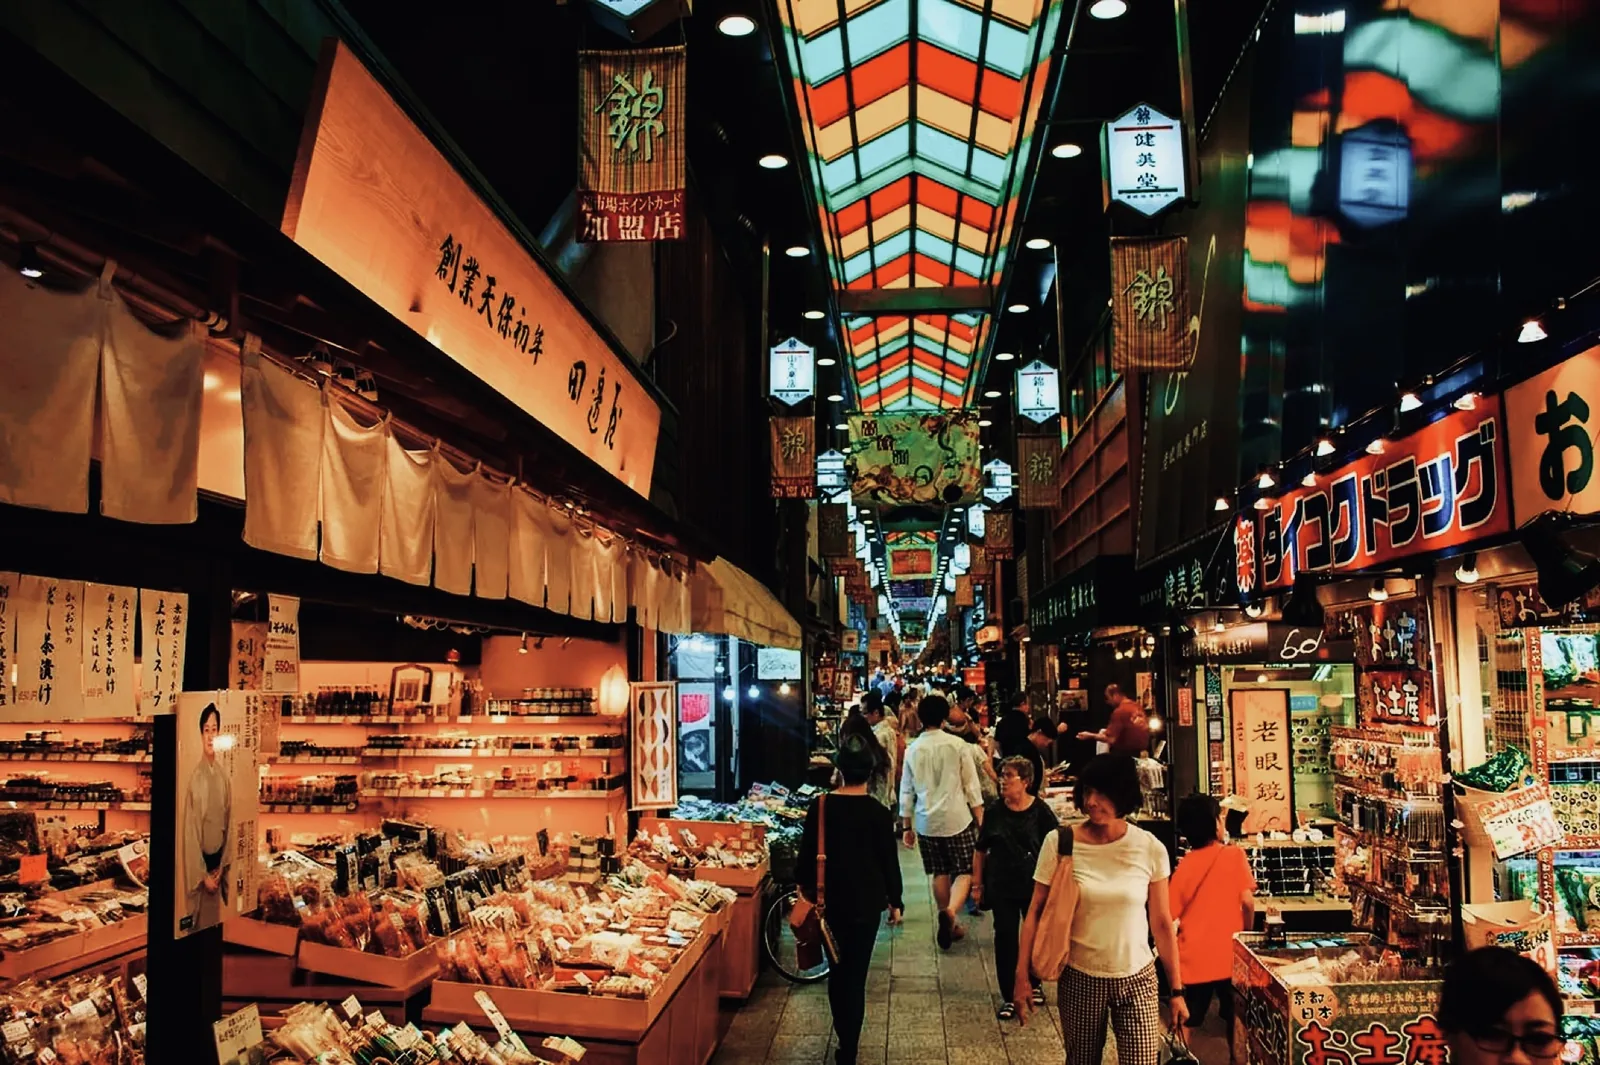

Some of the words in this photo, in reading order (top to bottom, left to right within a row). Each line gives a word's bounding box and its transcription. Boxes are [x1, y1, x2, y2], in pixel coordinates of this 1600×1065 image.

[595, 69, 665, 163] 錦
[1134, 132, 1160, 189] 健英堂
[583, 213, 682, 241] 加盟店
[435, 233, 544, 366] 創業天保初年
[1123, 265, 1176, 331] 錦
[780, 427, 806, 463] 錦
[1027, 451, 1053, 486] 錦
[1535, 389, 1594, 501] お
[1262, 416, 1496, 586] ダイコクドラッグ
[153, 599, 166, 707] 上だしスープ
[1373, 679, 1420, 722] お土産
[1252, 720, 1285, 802] 老眼鏡
[1293, 990, 1325, 1005] 京都
[1301, 1006, 1332, 1019] 日本
[1389, 1005, 1397, 1013] of
[1399, 1005, 1419, 1015] Kyoto
[1297, 1014, 1449, 1065] お土産
